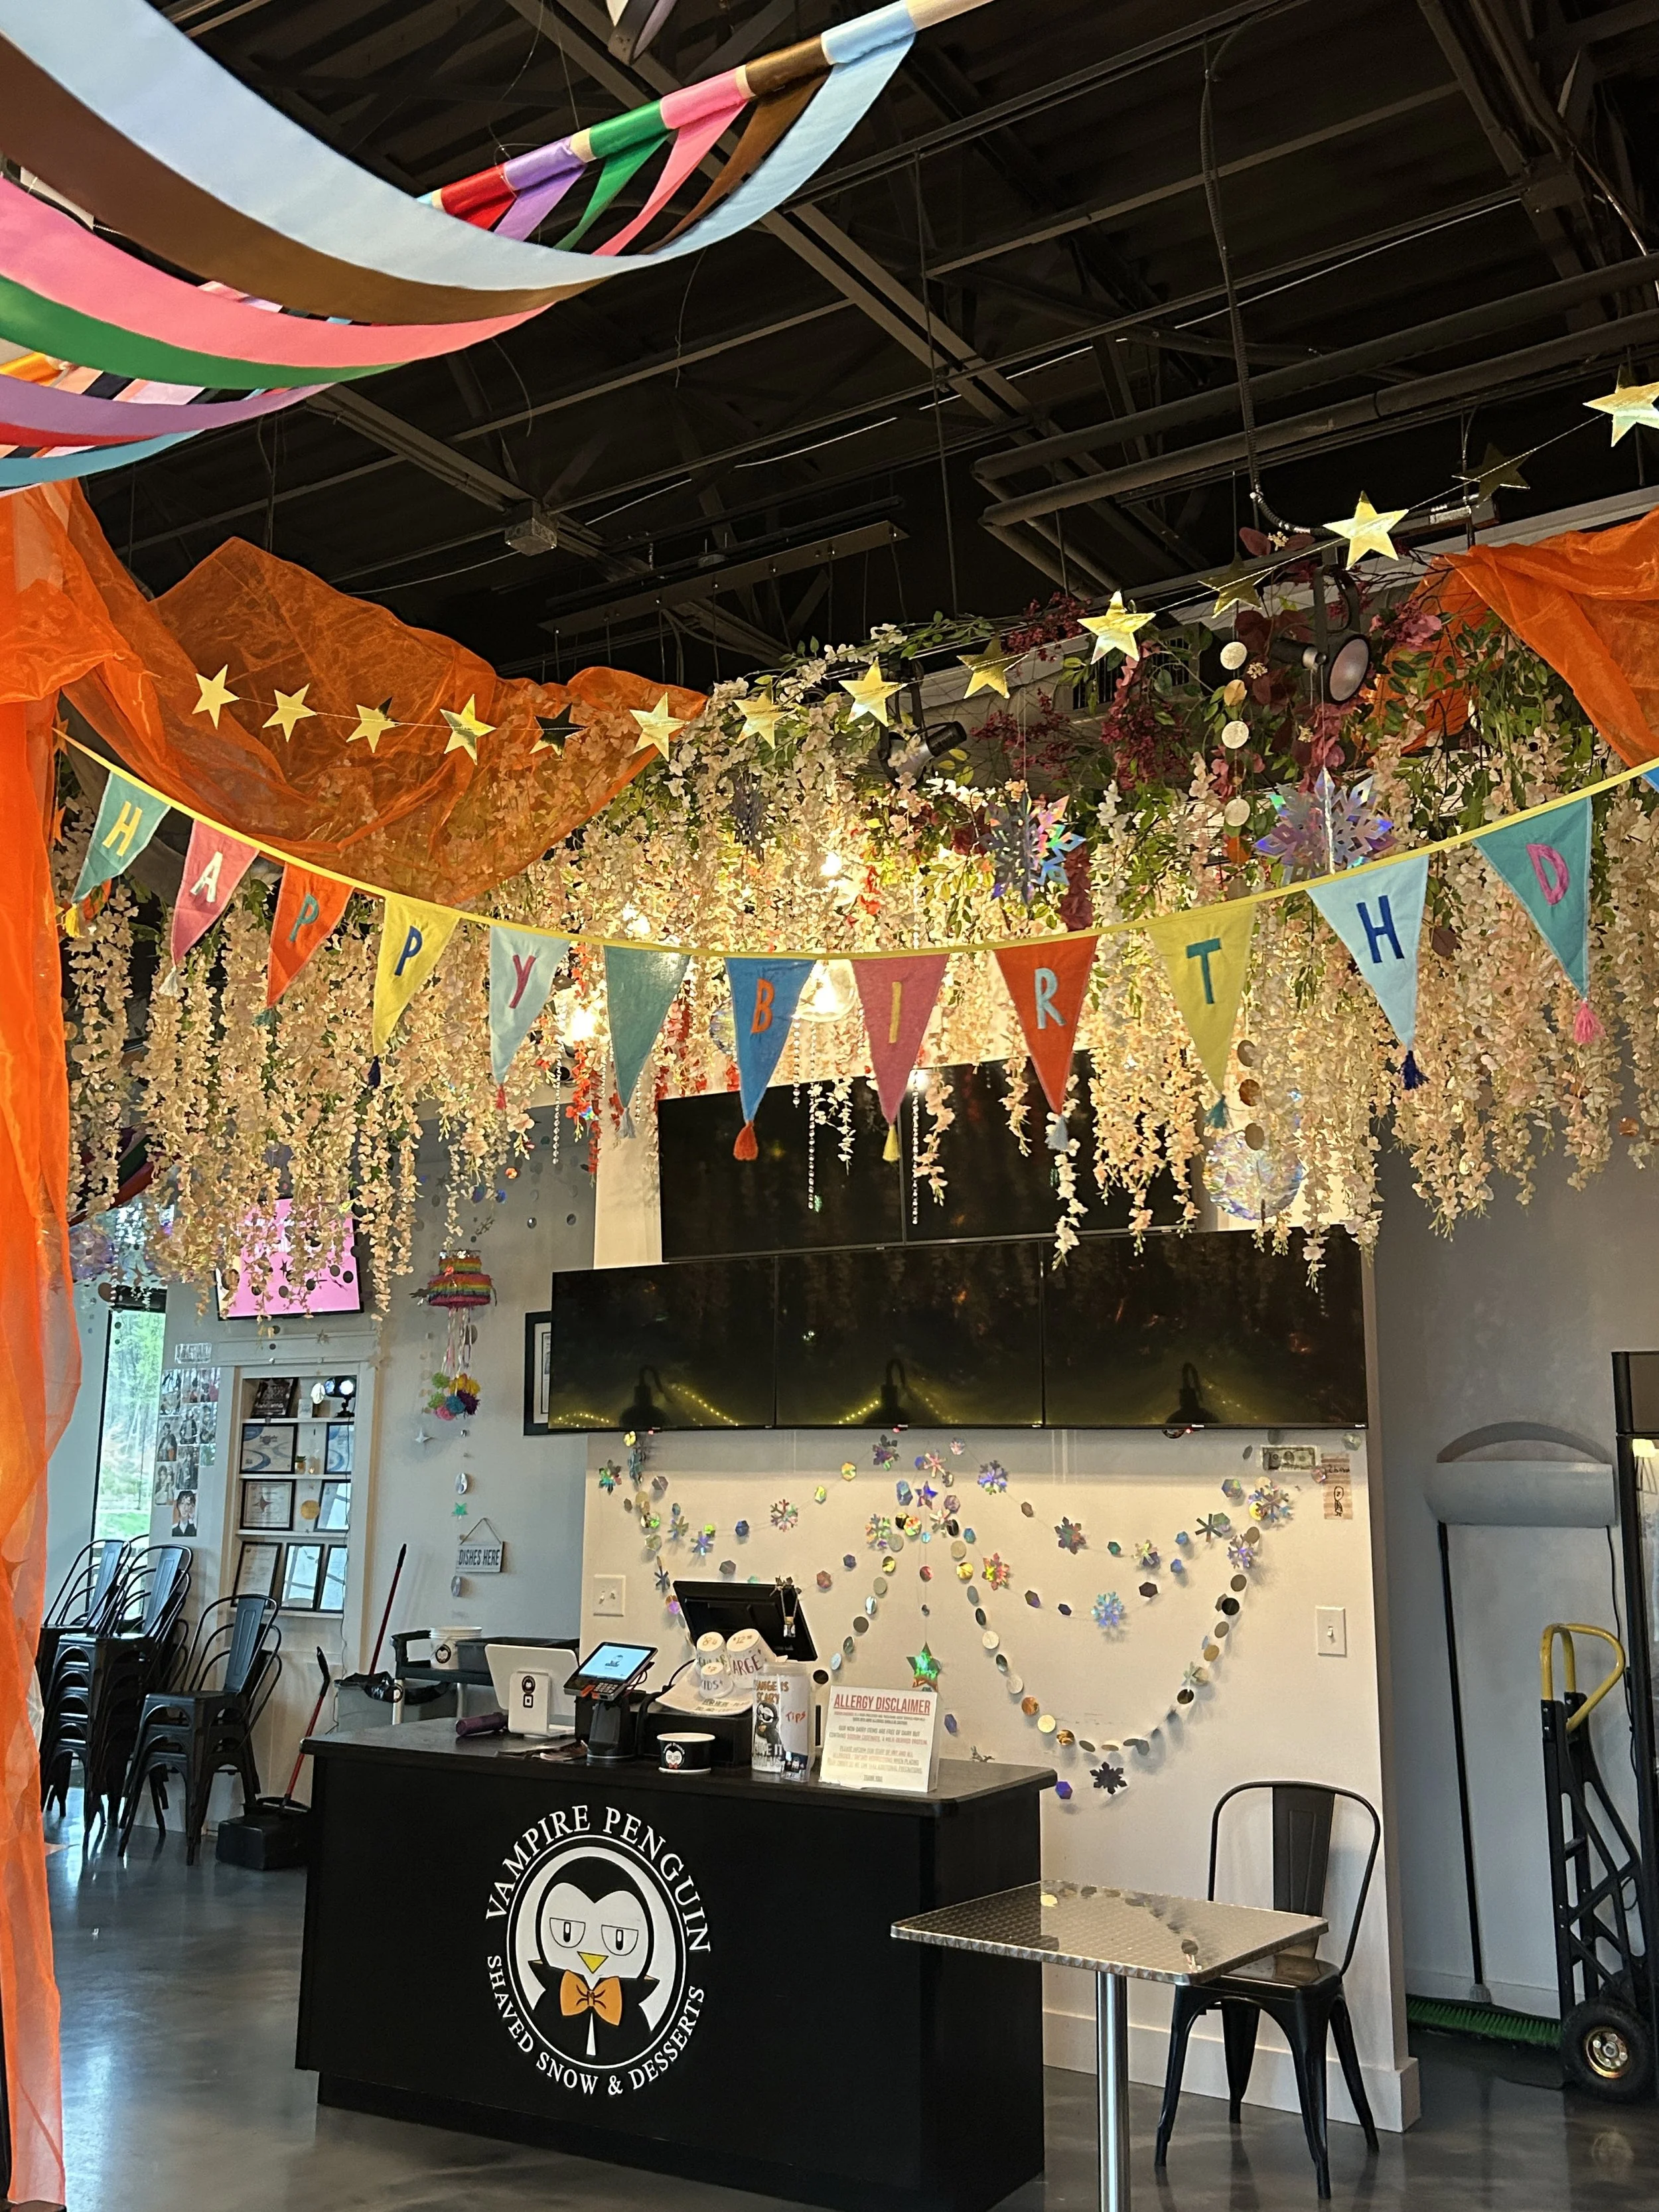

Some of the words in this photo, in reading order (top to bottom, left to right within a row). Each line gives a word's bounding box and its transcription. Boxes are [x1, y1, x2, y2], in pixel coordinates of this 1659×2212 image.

[103, 801, 538, 1009] HAPPY
[459, 1549, 482, 1566] DISHES
[482, 1550, 500, 1566] HERE
[702, 1680, 719, 1691] IDS
[834, 1694, 874, 1710] ALLERGY
[876, 1697, 931, 1714] DISCLAIMER
[486, 1804, 591, 1921] VAMPIRE
[603, 1806, 712, 1954] PENGUIN
[486, 1954, 534, 2054] SHAVED
[536, 2051, 599, 2095] SNOW
[607, 2075, 624, 2096] &
[631, 1984, 705, 2091] DESSERTS
